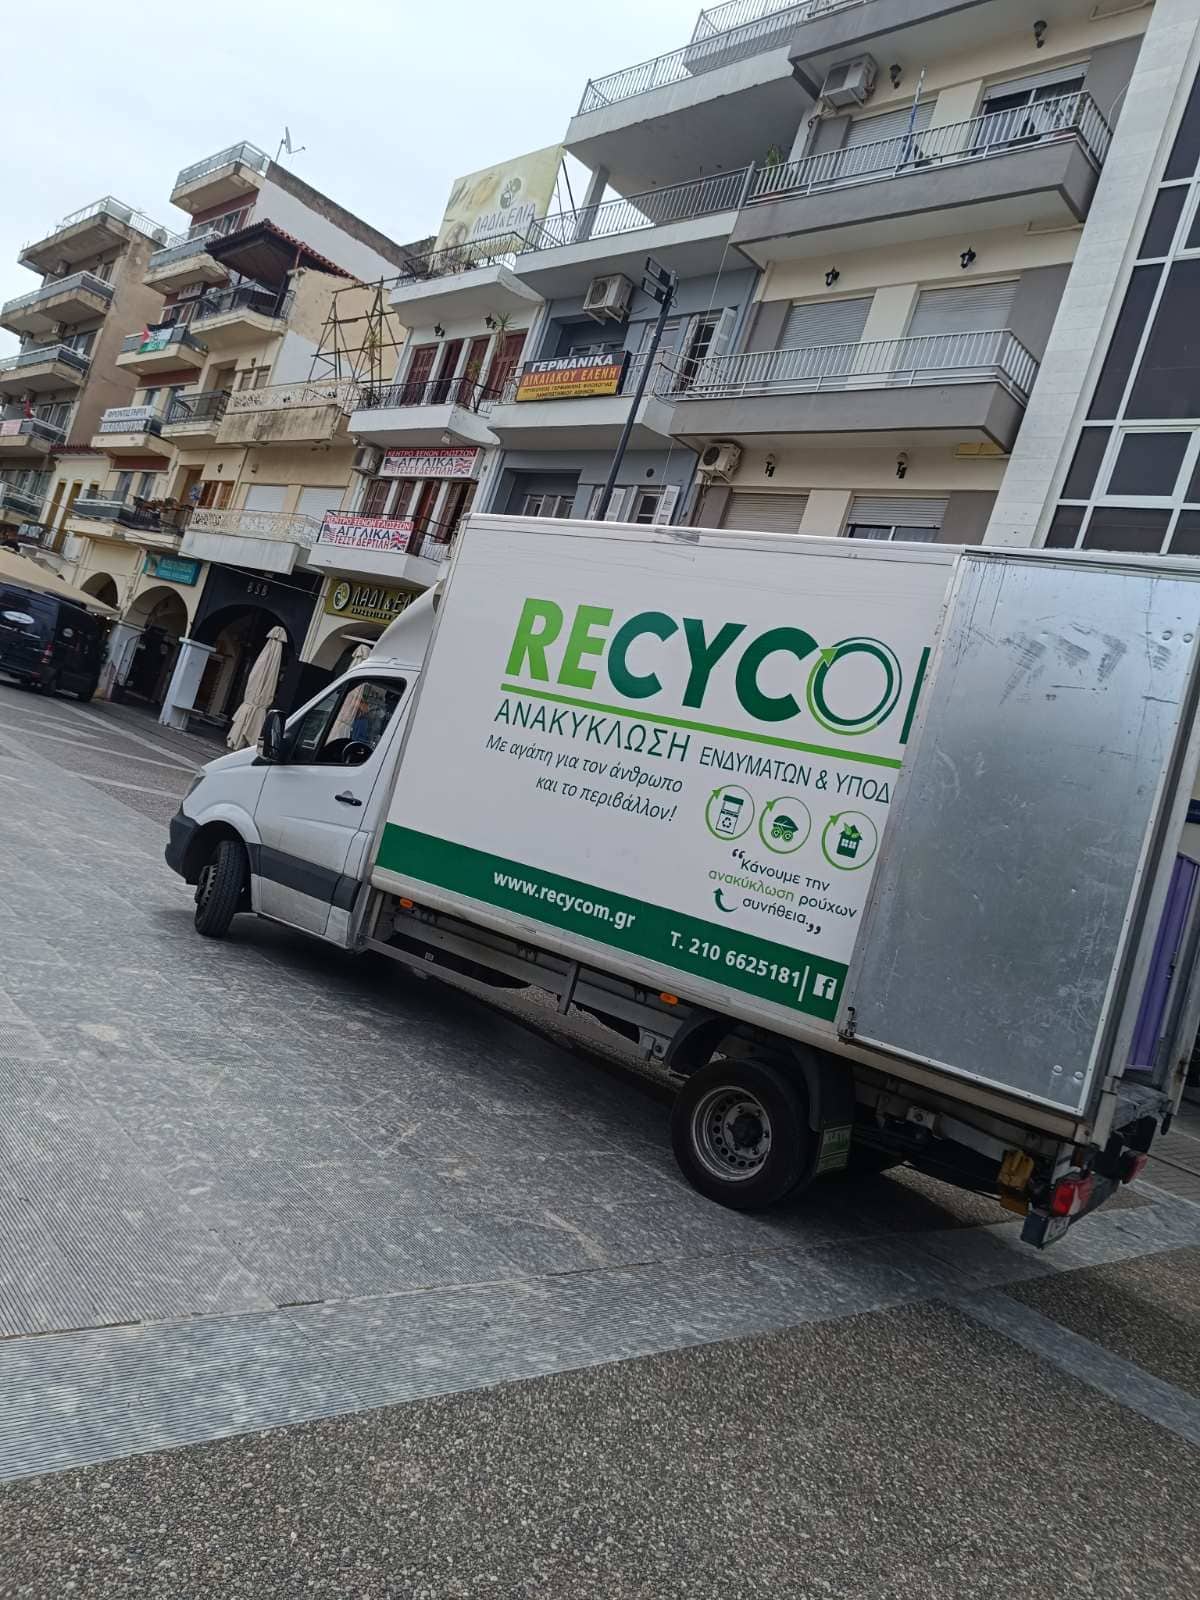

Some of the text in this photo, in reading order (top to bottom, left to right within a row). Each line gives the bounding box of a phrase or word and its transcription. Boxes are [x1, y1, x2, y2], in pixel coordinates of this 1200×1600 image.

[473, 212, 501, 234] ΛΑΔΙ
[506, 203, 536, 227] ΕΛΙΑ
[523, 367, 617, 386] ΔΙΚΑΙΑΚΟΥ ΕΛΕΝΗ
[531, 354, 613, 372] ΓΕΡΜΑΝΙΚΑ
[399, 457, 454, 468] ΑΓΓΛΙΚΑ
[326, 516, 352, 525] ΚΕΝΤΡΟ
[337, 526, 391, 540] ΑΓΓΛΙΚΑ
[352, 586, 385, 609] ΛΑΔΙ
[392, 592, 413, 613] ΕΛ
[506, 598, 931, 745] RECYCO
[486, 734, 683, 793] Με αγάπη για τον άνθρωπο
[494, 699, 890, 804] ΑΝΑΚΥΚΛΩΣΗ ΕΝΔΥΜΑΤΩΝ & ΥΠΟΔ
[536, 776, 678, 822] και το περιβάλλον!
[708, 868, 858, 918] ανακύκλωση ρούχων
[805, 876, 831, 893] την
[494, 871, 636, 930] www.recycom.gr
[671, 931, 800, 987] T. 210 6625181
